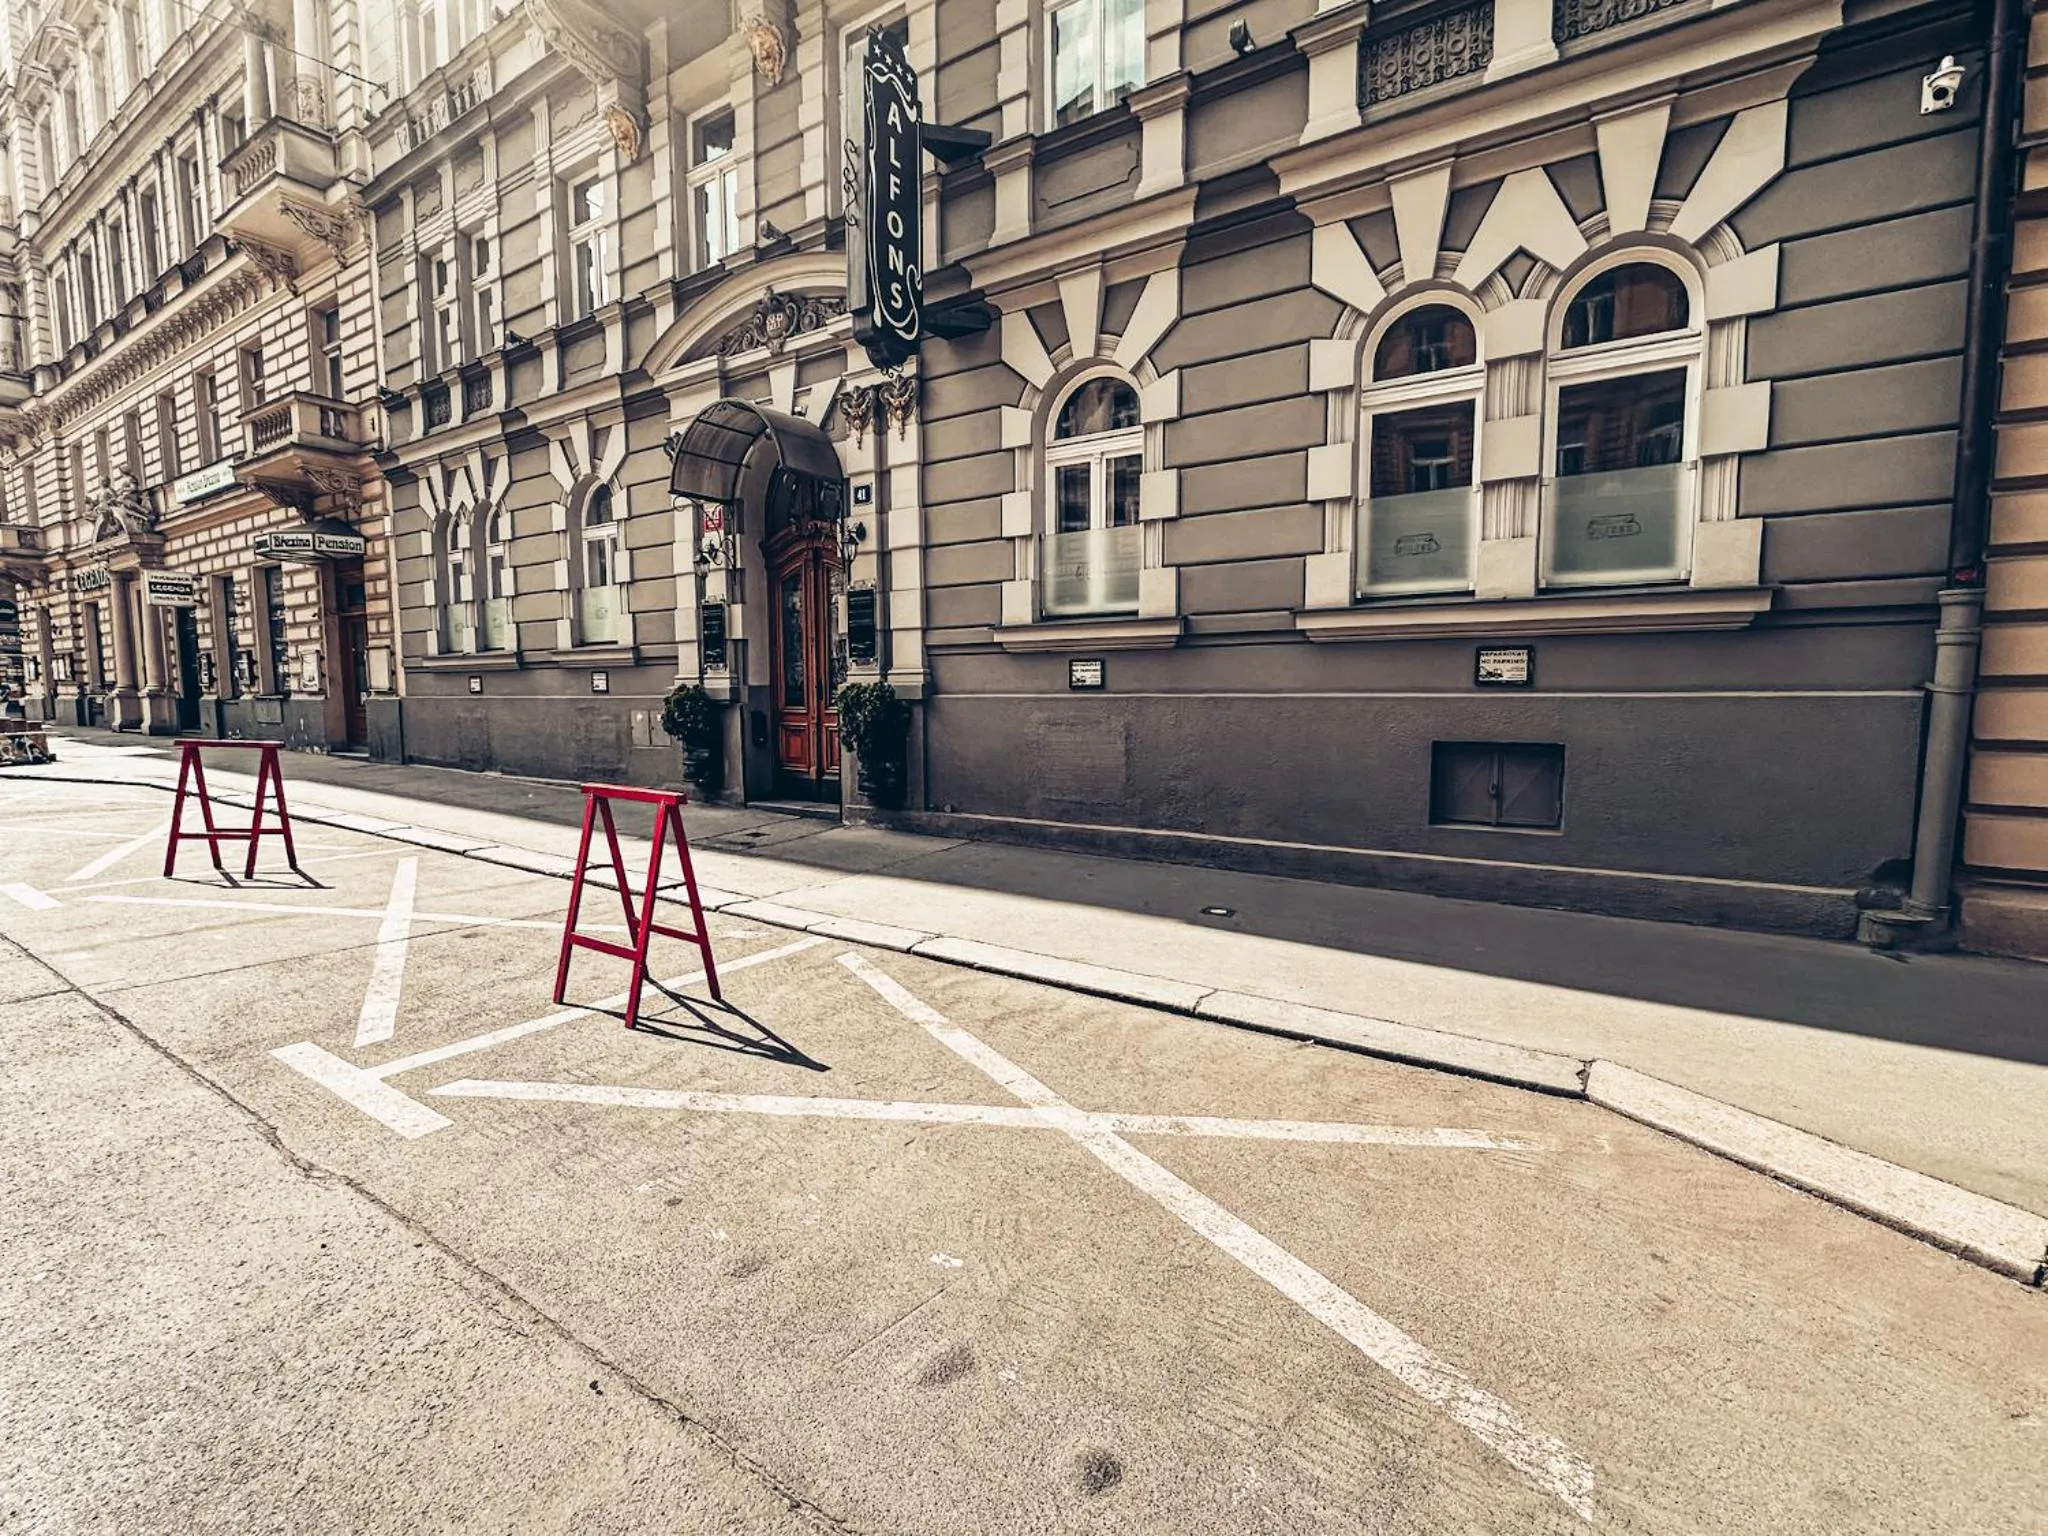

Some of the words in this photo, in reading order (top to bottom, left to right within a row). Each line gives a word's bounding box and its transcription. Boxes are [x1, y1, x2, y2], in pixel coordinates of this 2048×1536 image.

[886, 101, 904, 309] ALFONS
[317, 536, 362, 551] Pension
[151, 584, 191, 592] LEGENDA
